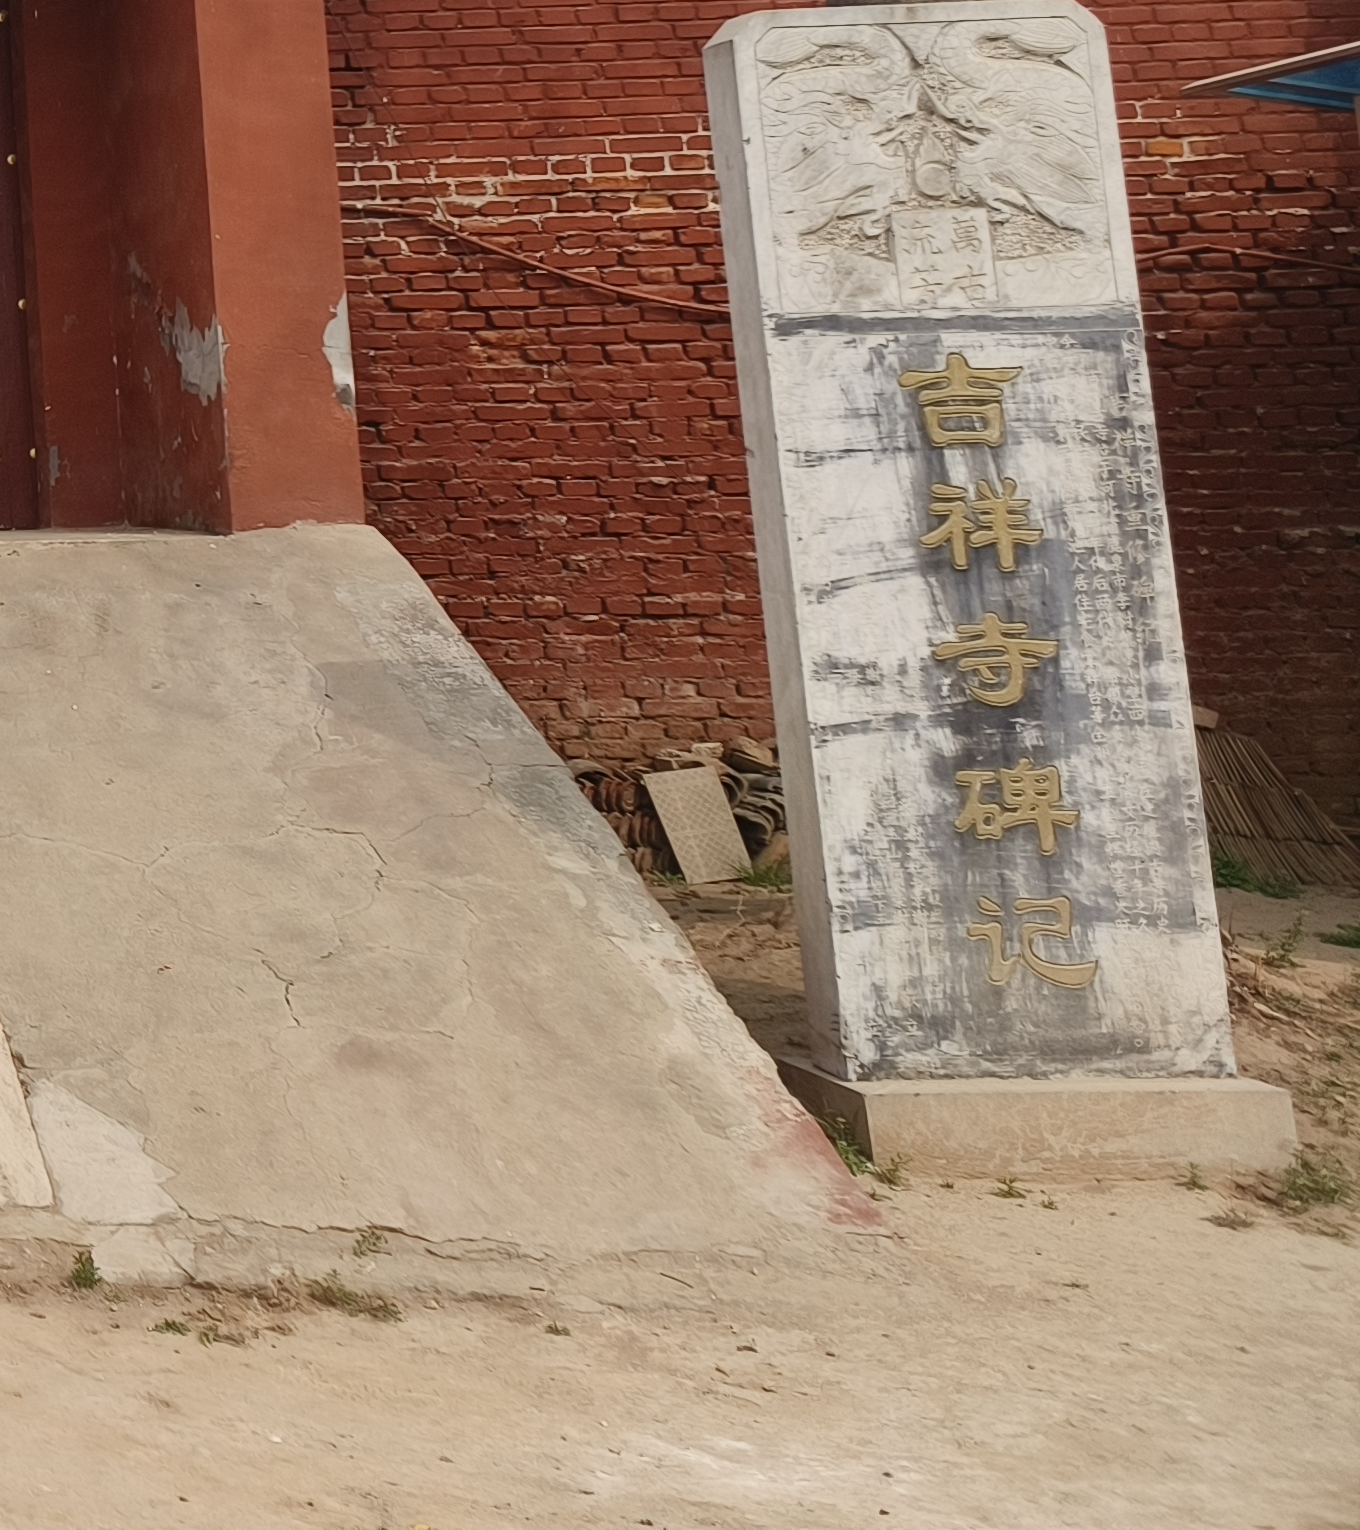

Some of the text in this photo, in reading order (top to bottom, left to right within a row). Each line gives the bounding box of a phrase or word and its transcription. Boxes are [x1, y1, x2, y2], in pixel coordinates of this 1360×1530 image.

[897, 351, 1099, 990] 吉祥寺碑记
